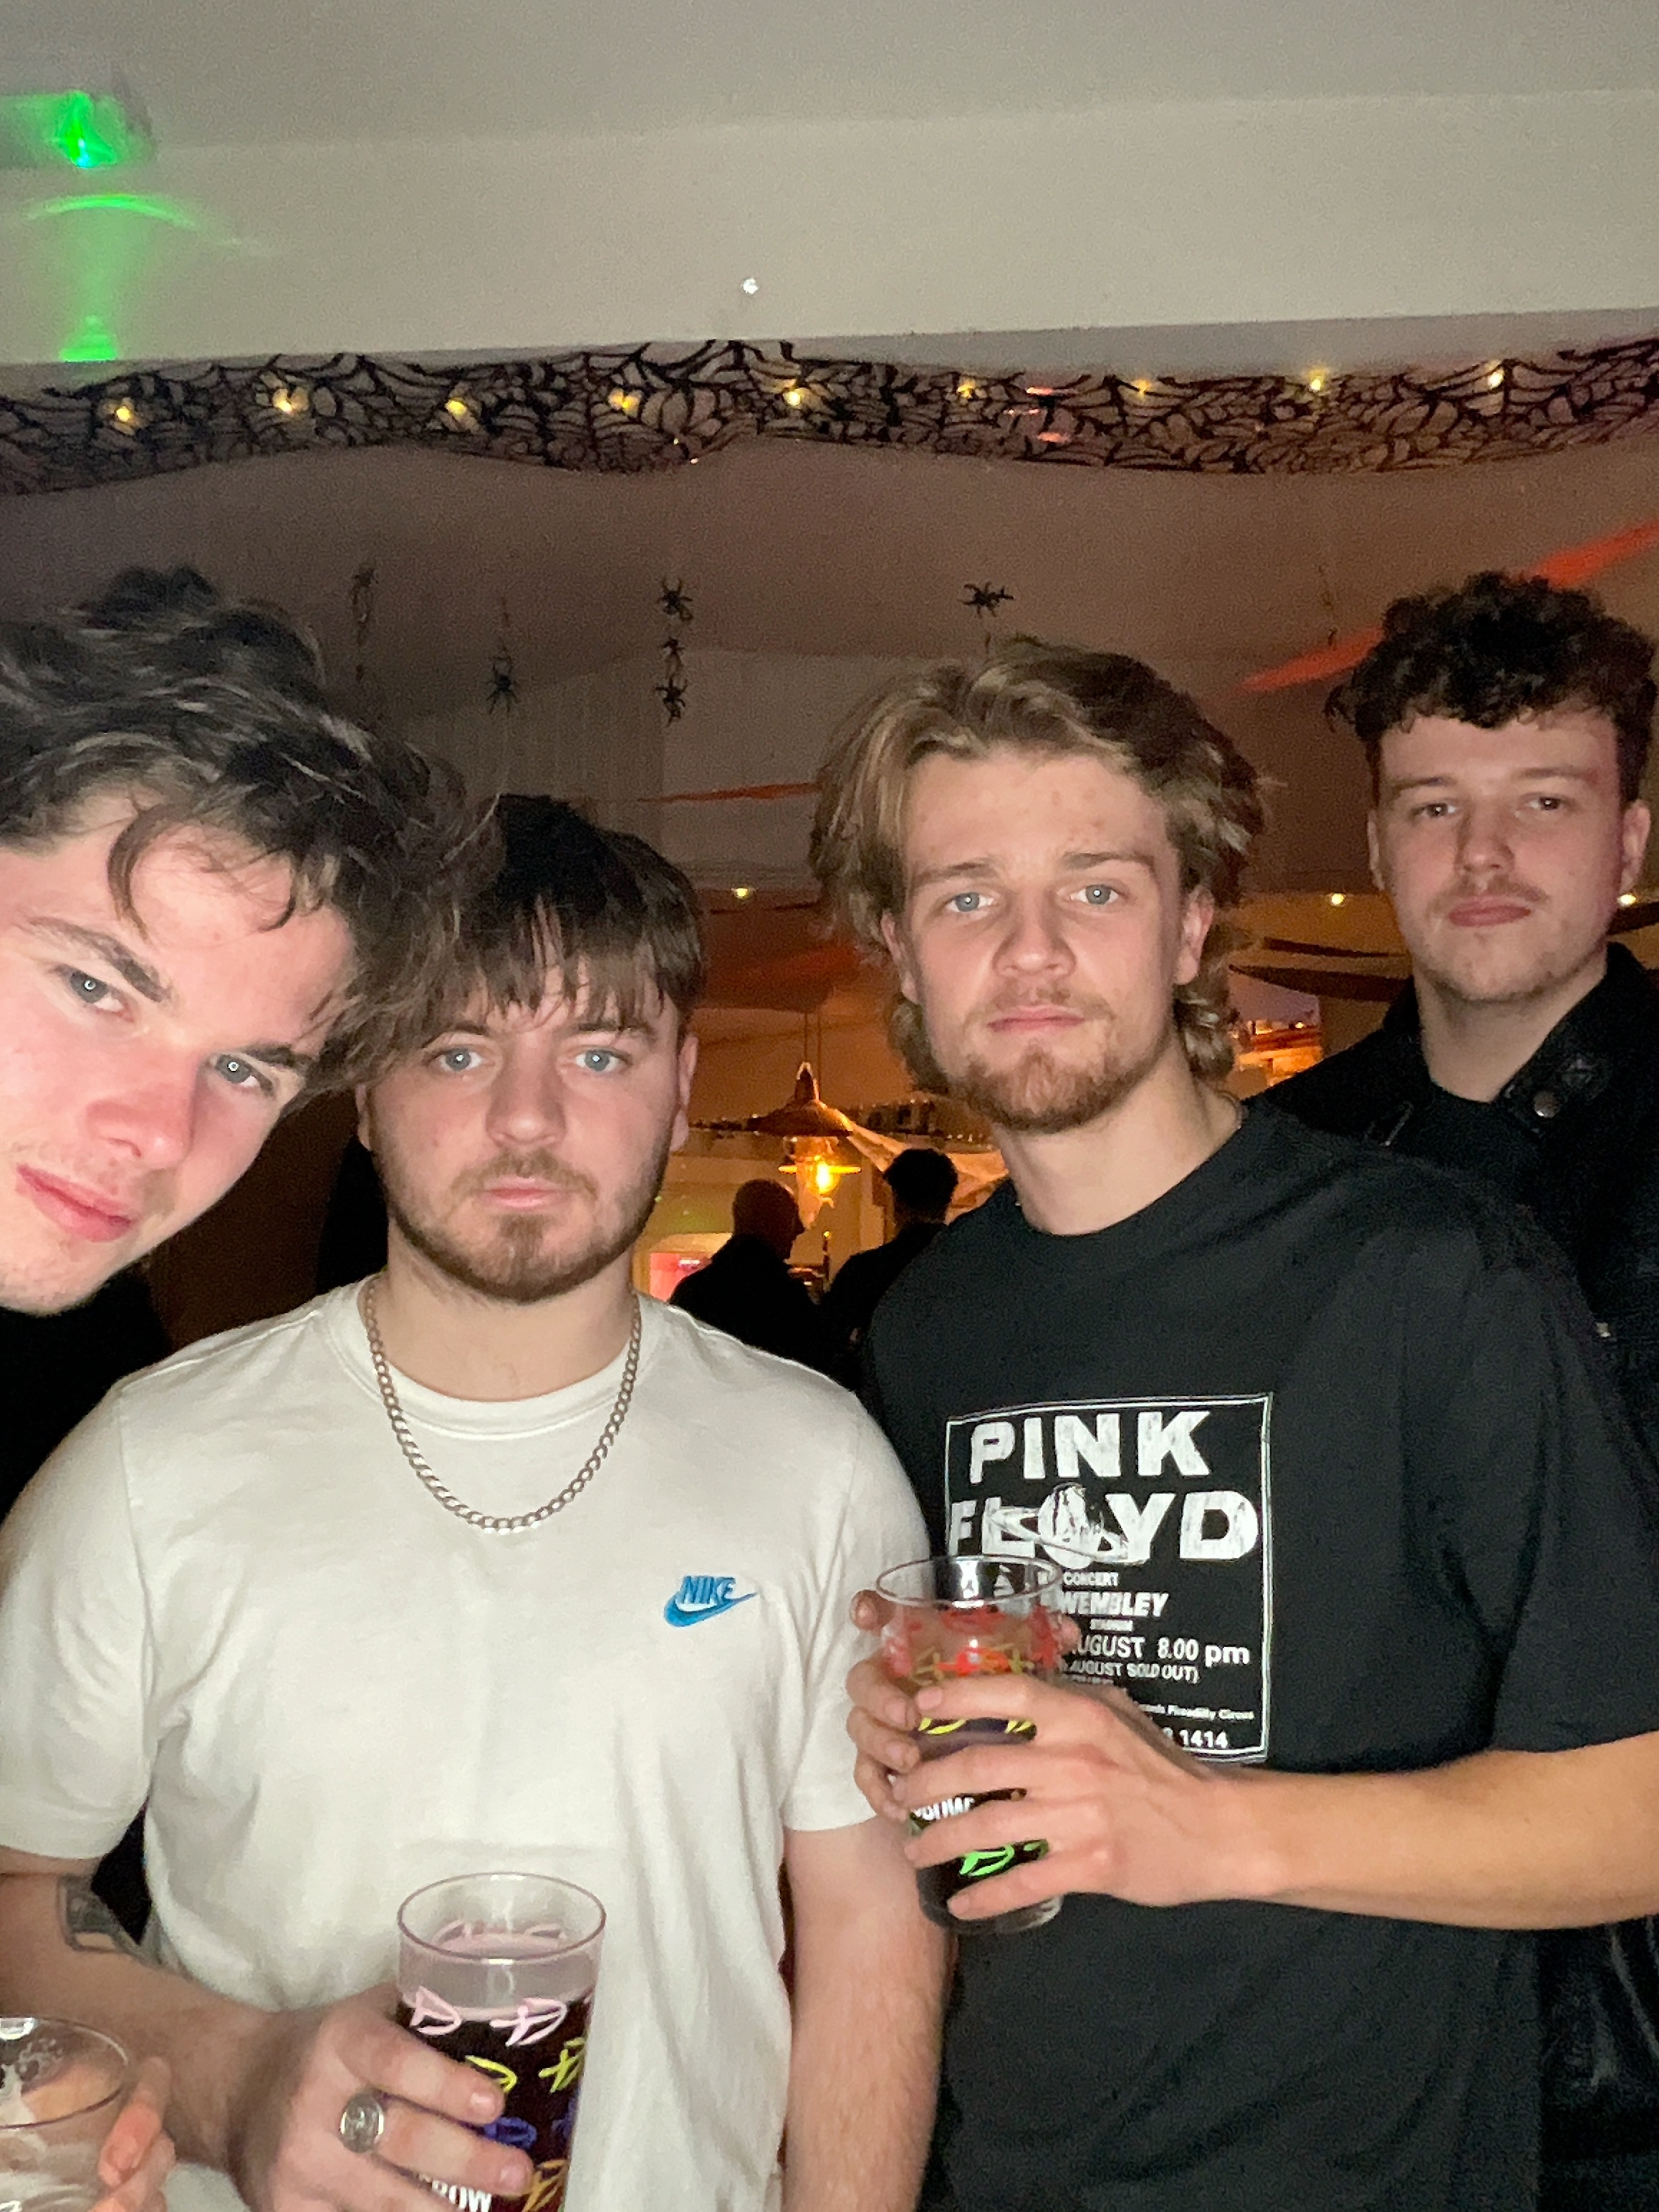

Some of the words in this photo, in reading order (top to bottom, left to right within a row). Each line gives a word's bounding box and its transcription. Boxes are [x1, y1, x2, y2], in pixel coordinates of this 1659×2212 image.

[969, 1410, 1211, 1484] PINK
[948, 1490, 1259, 1569] FLOYD
[675, 1575, 736, 1605] NIKE
[1055, 1591, 1170, 1617] WEMBLEY
[1072, 1634, 1146, 1659] UGUST
[1157, 1636, 1200, 1661] 8.00
[1205, 1645, 1250, 1668] pm
[1127, 1663, 1160, 1678] SOLD
[1179, 1728, 1228, 1749] 1414
